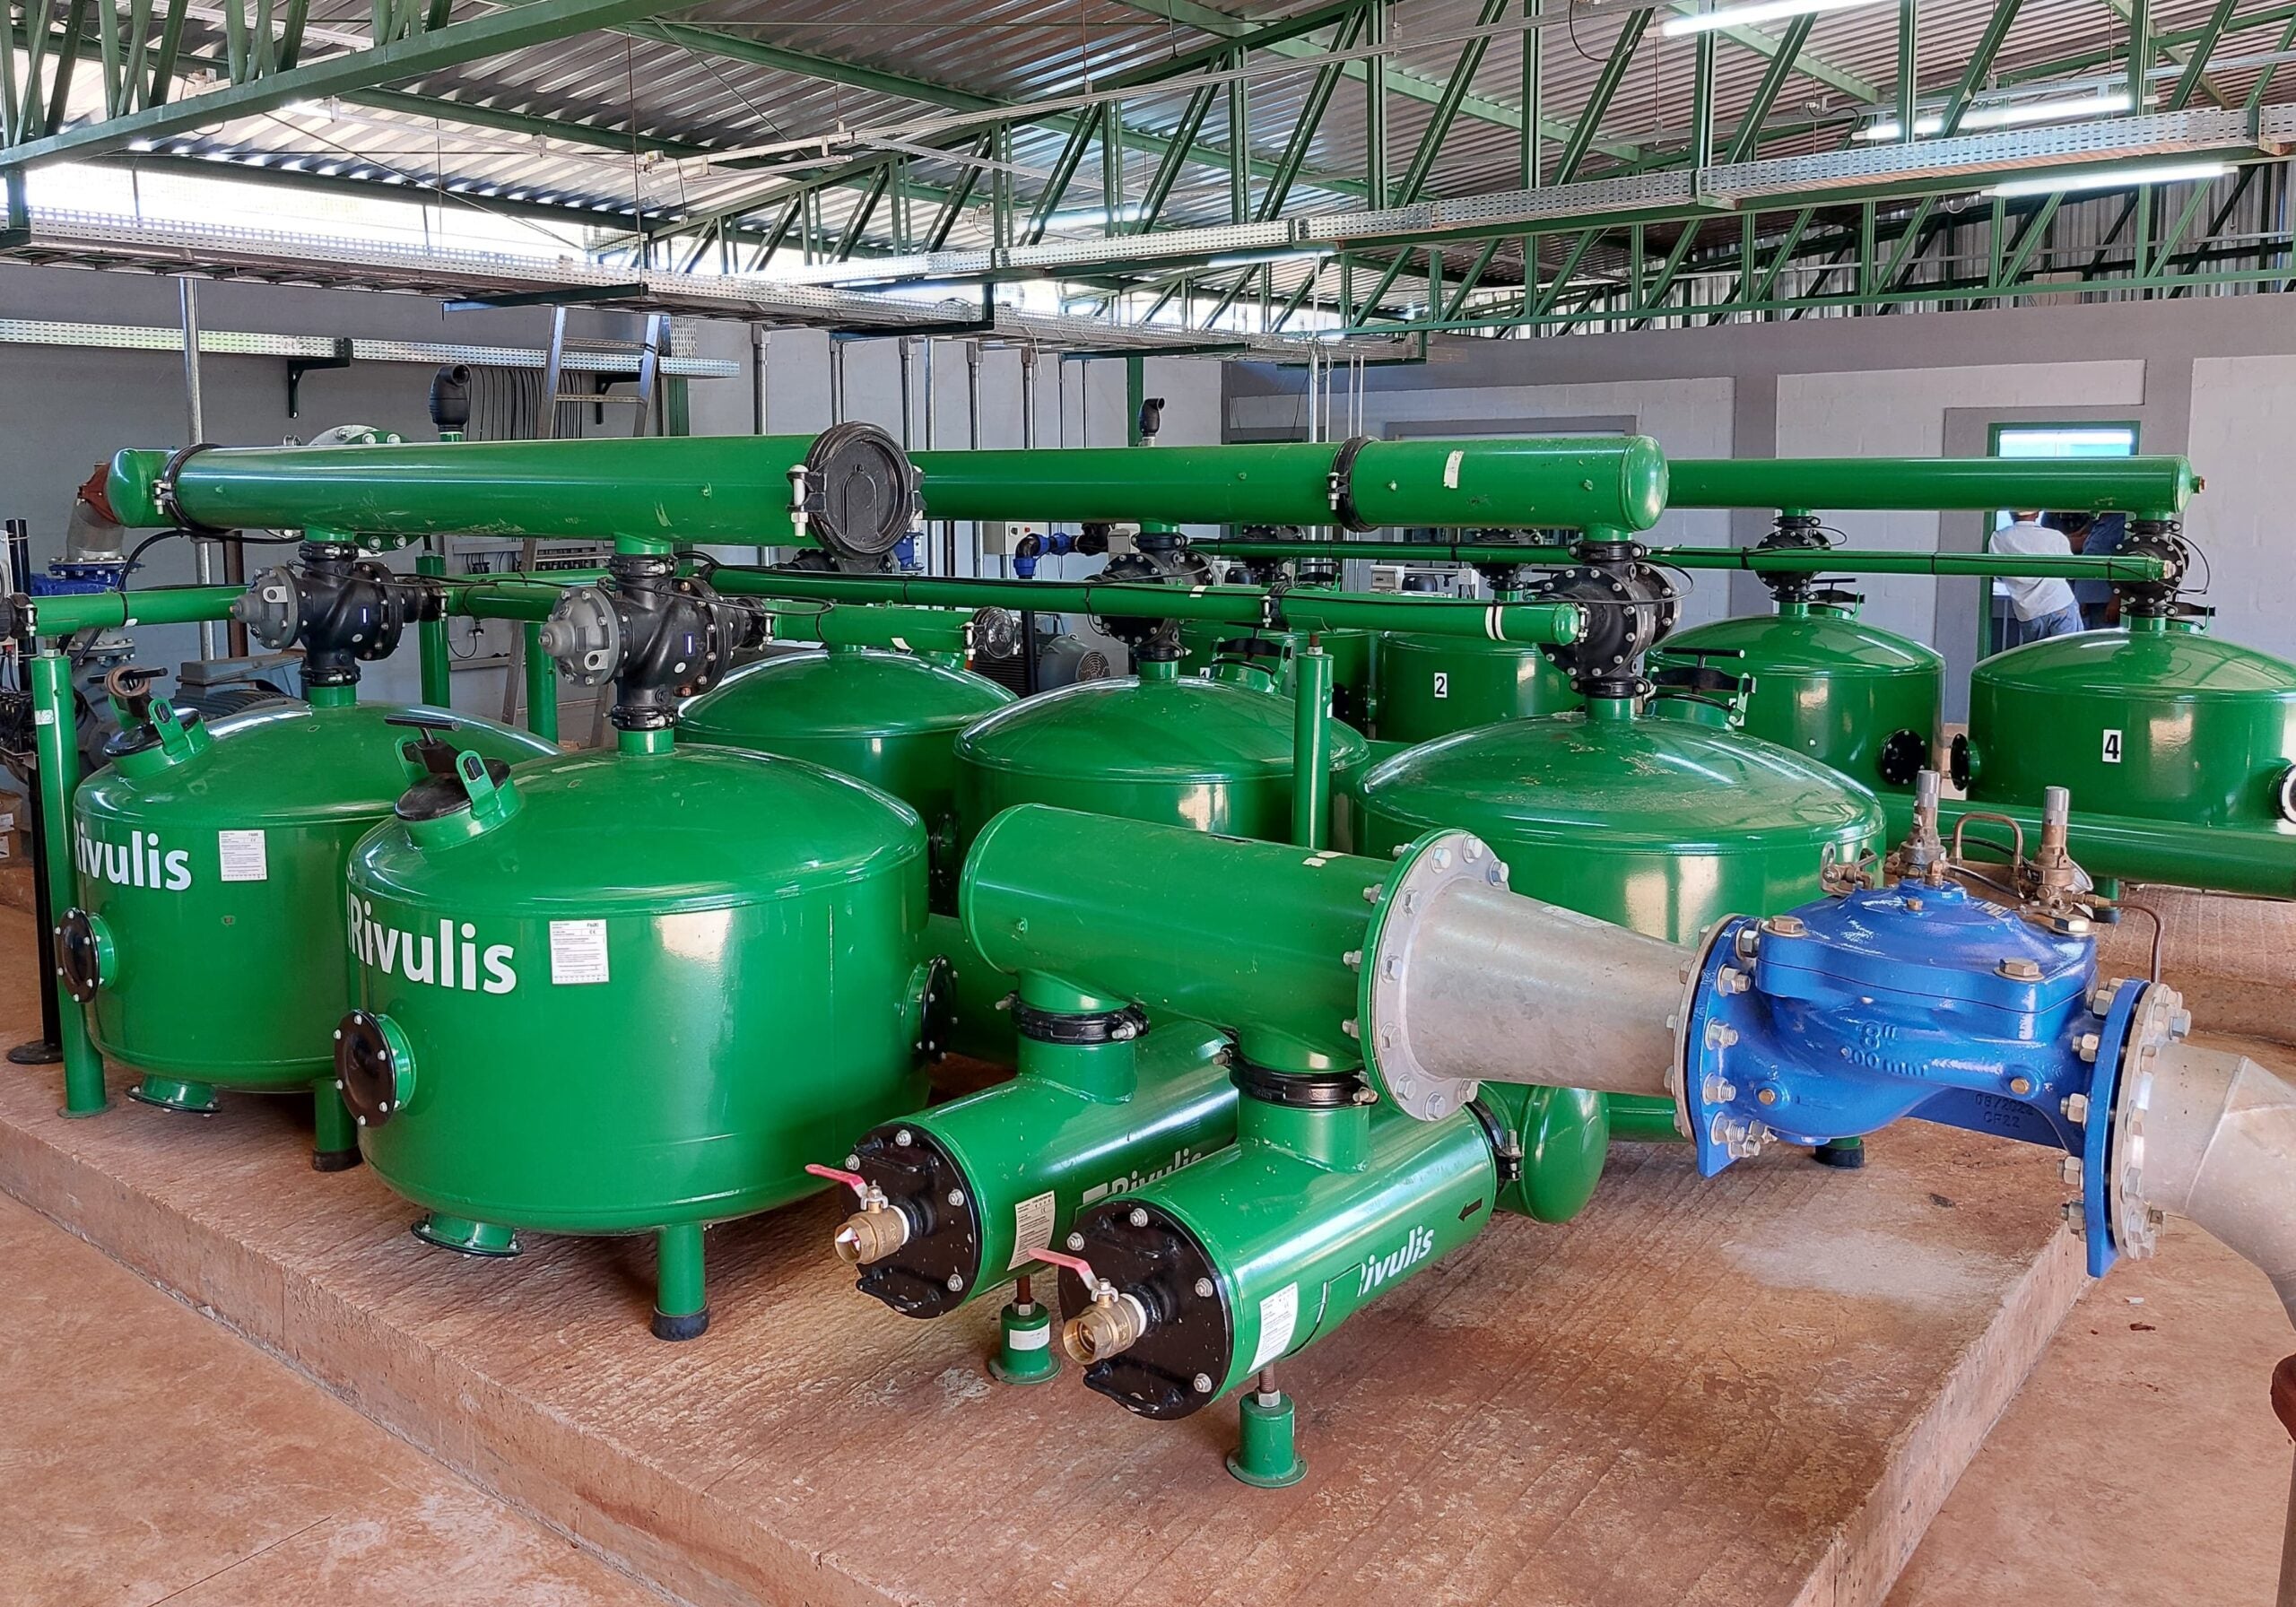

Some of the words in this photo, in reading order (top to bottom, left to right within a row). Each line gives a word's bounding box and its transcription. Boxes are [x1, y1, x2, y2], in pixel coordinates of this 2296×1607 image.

[1435, 675, 1446, 695] 2
[2104, 734, 2119, 760] 4
[74, 817, 192, 890] Rivulis
[350, 892, 517, 995] Rivulis
[1983, 1111, 2021, 1128] CF22
